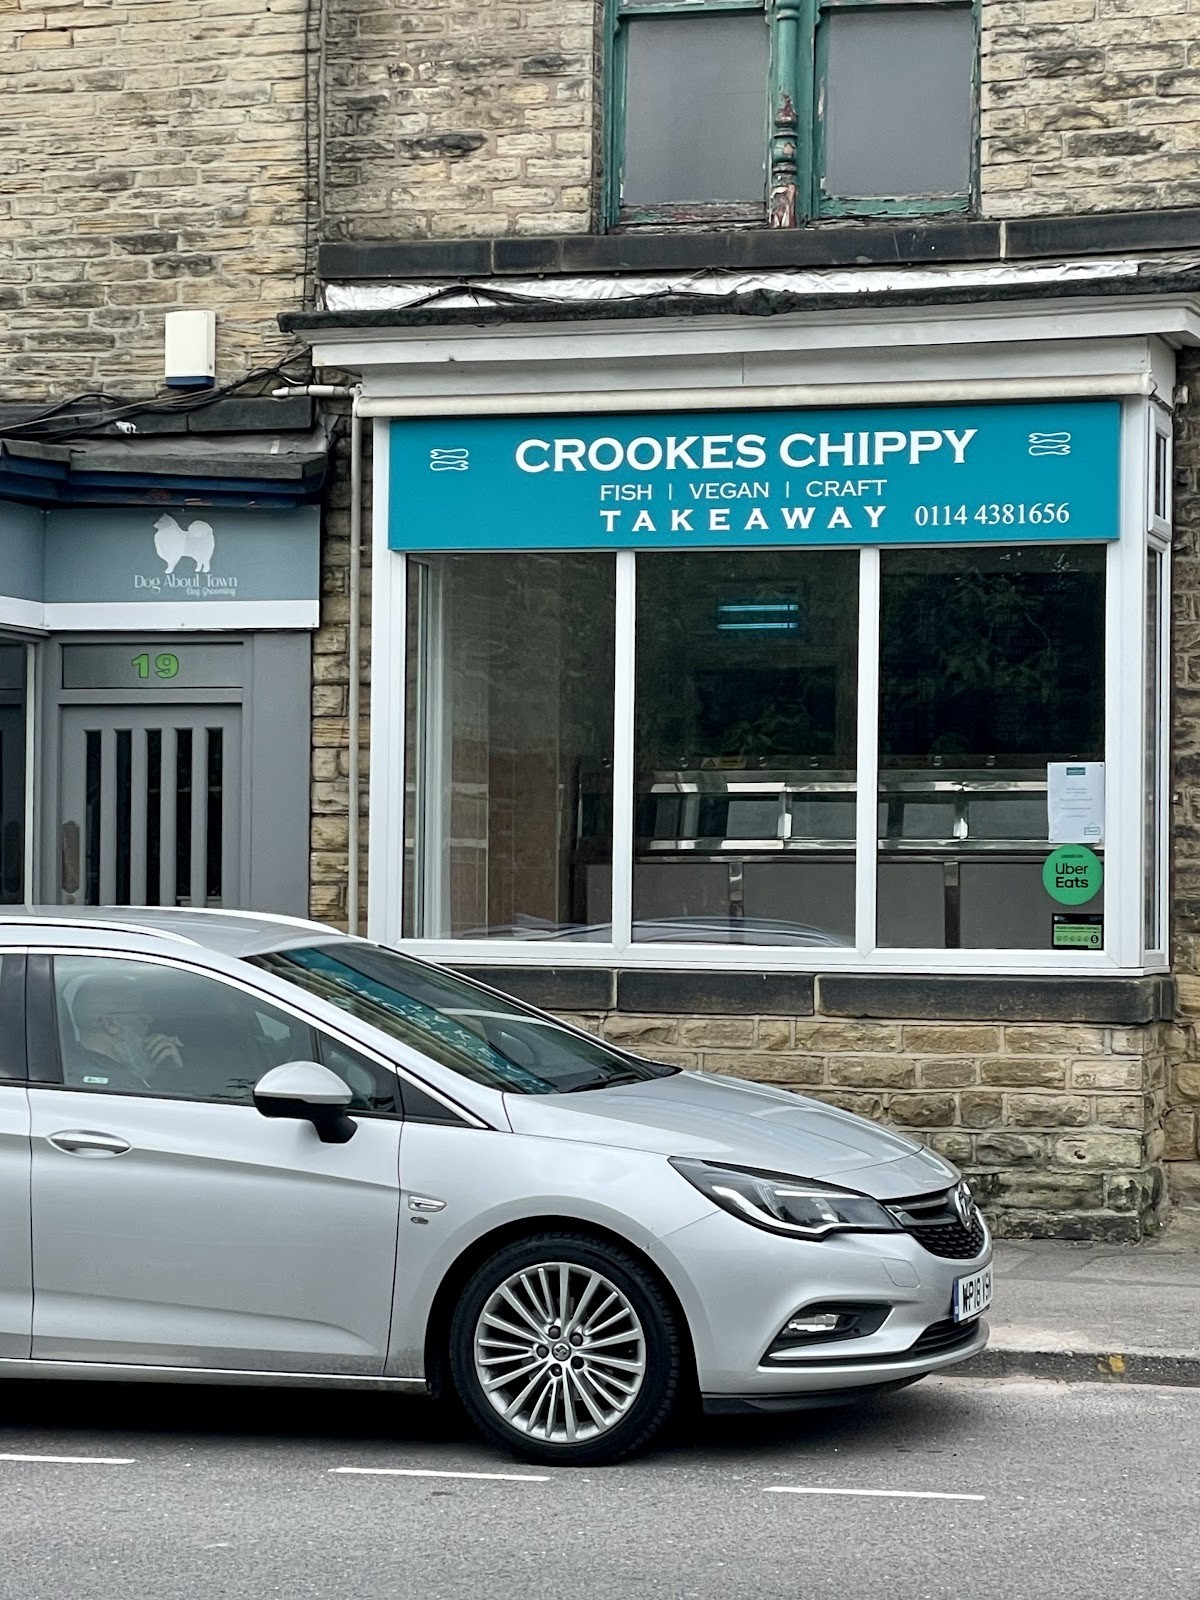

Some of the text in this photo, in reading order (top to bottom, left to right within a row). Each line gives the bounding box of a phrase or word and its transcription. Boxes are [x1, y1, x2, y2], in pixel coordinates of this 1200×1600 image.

[514, 428, 978, 473] CROOKES CHIPPY
[600, 479, 888, 501] FISH VEGAN CRAFT
[599, 505, 887, 532] TAKEAWAY
[914, 502, 1070, 527] 0114 4381656
[134, 573, 238, 595] Dog About Town
[131, 653, 179, 679] 19
[1055, 862, 1089, 875] Uber
[1055, 876, 1089, 889] Eats
